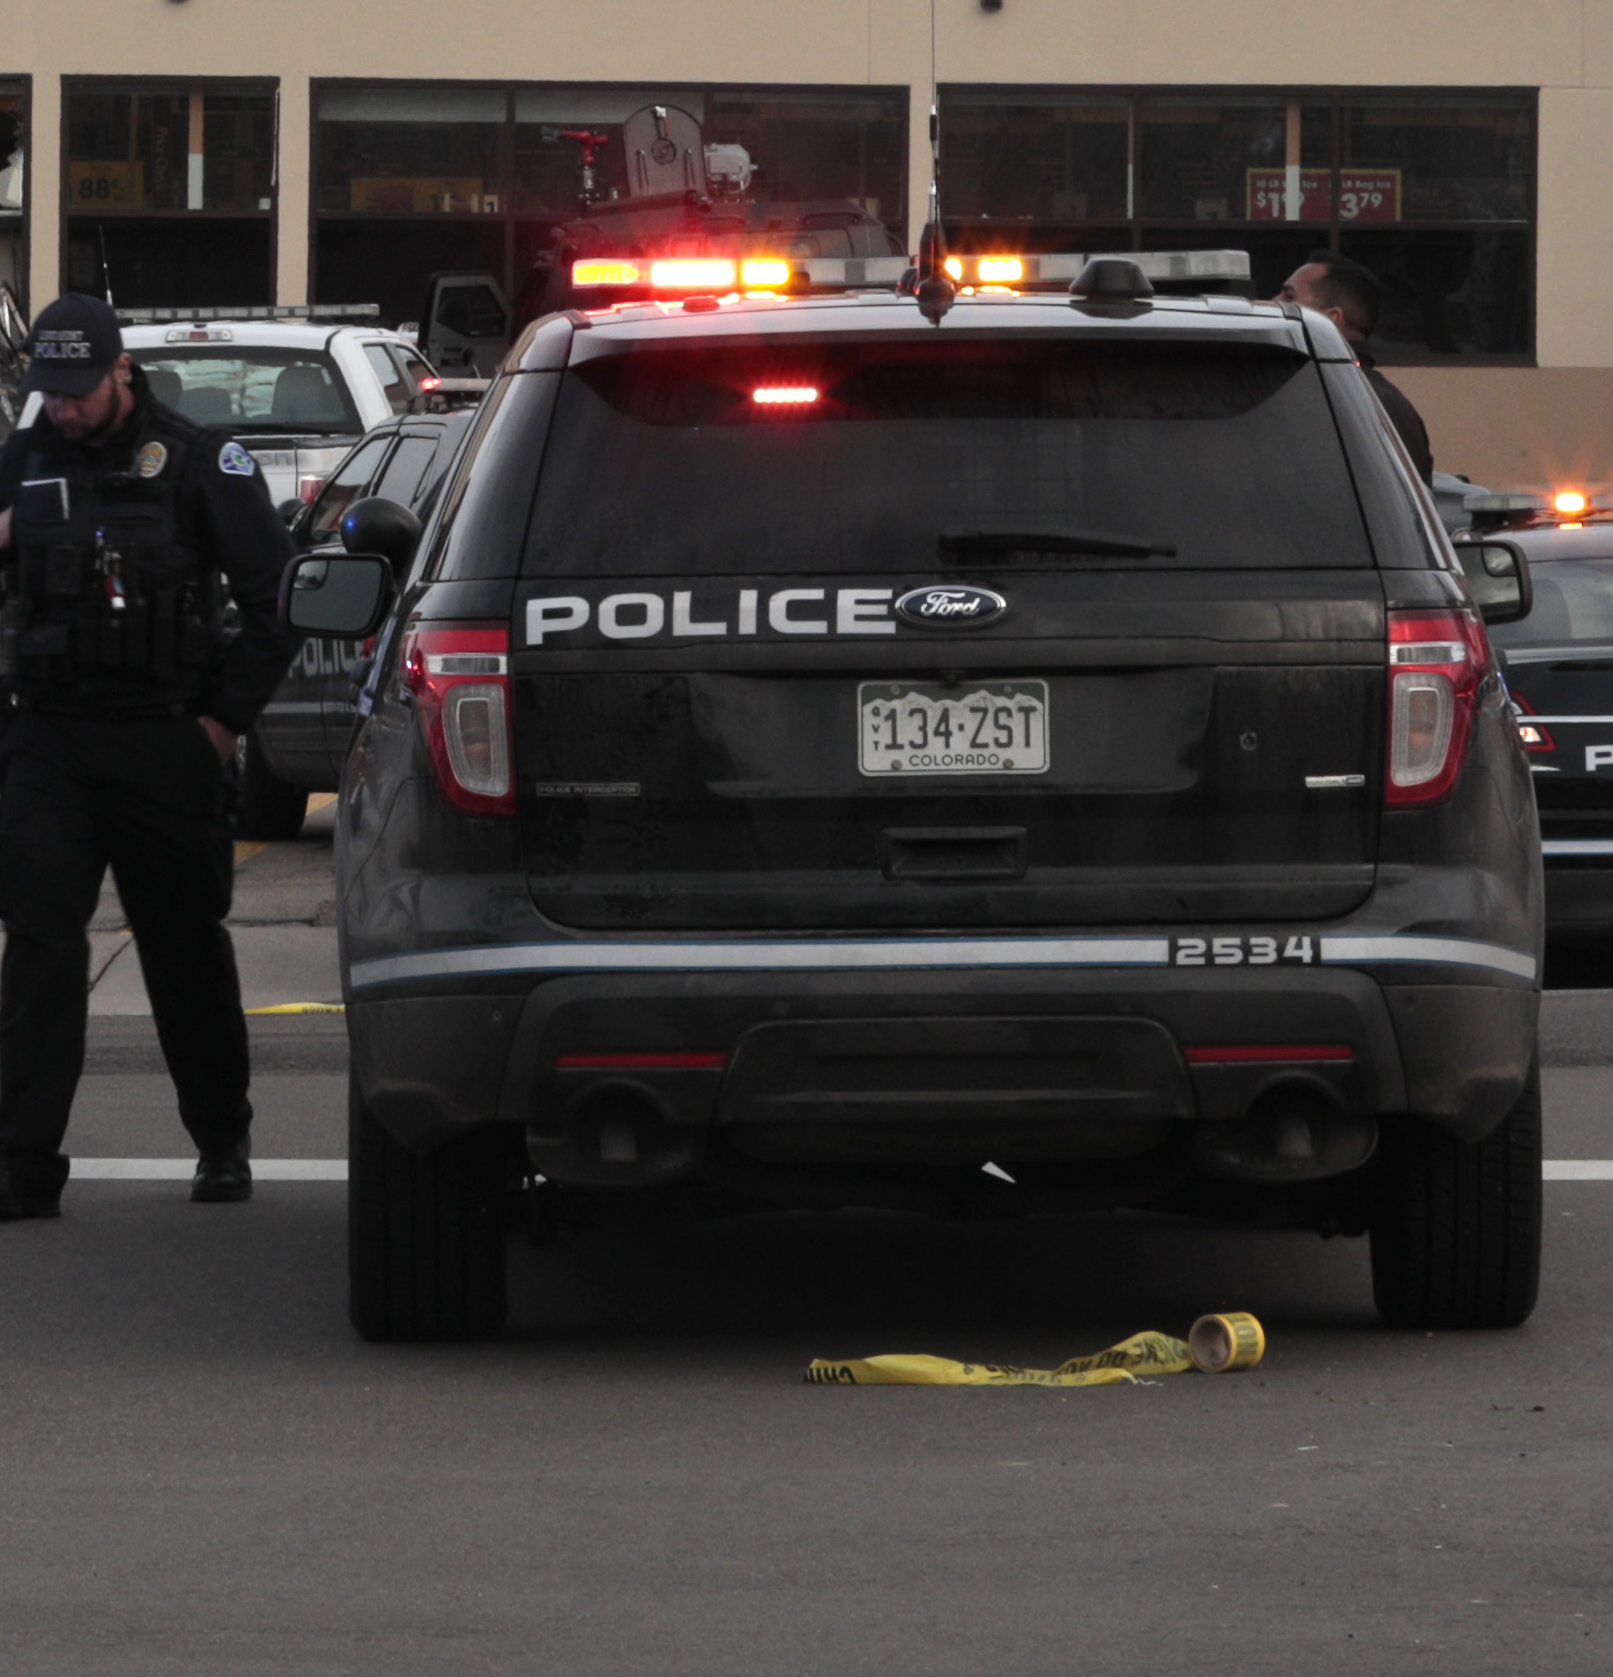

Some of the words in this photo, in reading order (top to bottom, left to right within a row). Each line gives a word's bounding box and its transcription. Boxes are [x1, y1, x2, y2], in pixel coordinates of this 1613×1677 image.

[35, 342, 91, 358] POLICE
[526, 587, 897, 645] POLICE
[920, 591, 981, 619] Ford
[288, 637, 363, 678] OLIC
[908, 753, 1001, 767] COLORADO
[1176, 935, 1313, 965] 2534
